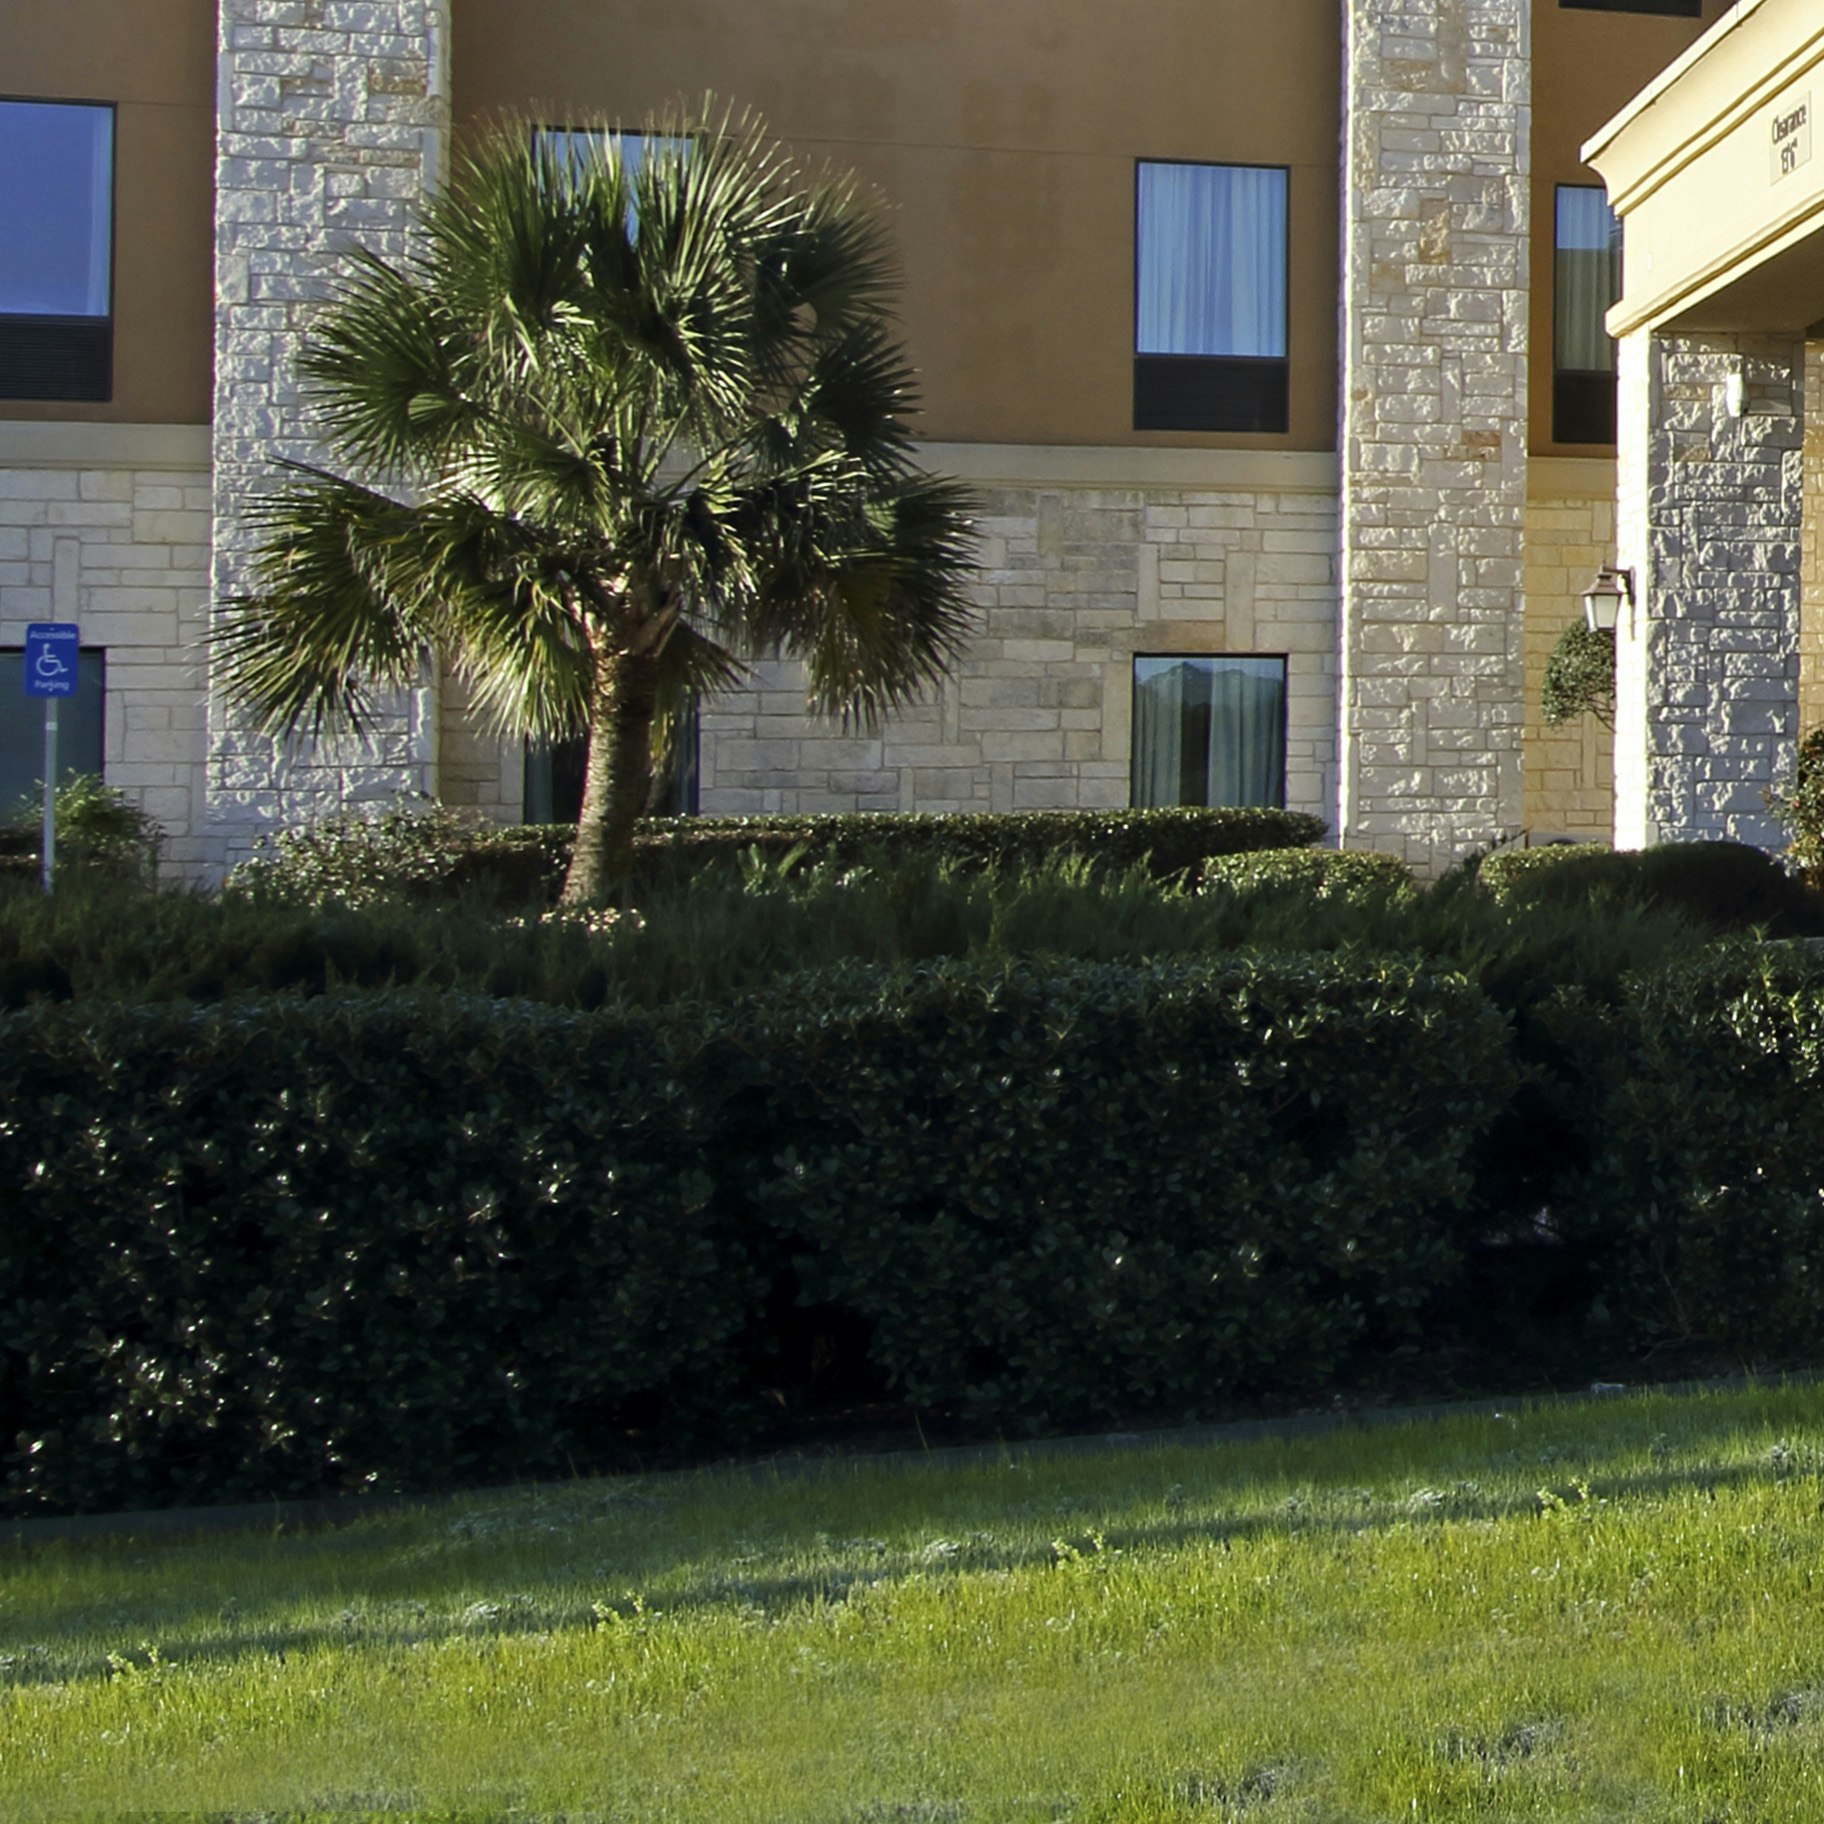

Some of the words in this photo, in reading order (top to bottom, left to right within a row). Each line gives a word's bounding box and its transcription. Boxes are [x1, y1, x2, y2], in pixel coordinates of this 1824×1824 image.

[1772, 103, 1806, 145] Clearance
[30, 630, 76, 640] Accessible
[34, 680, 70, 691] Parking
